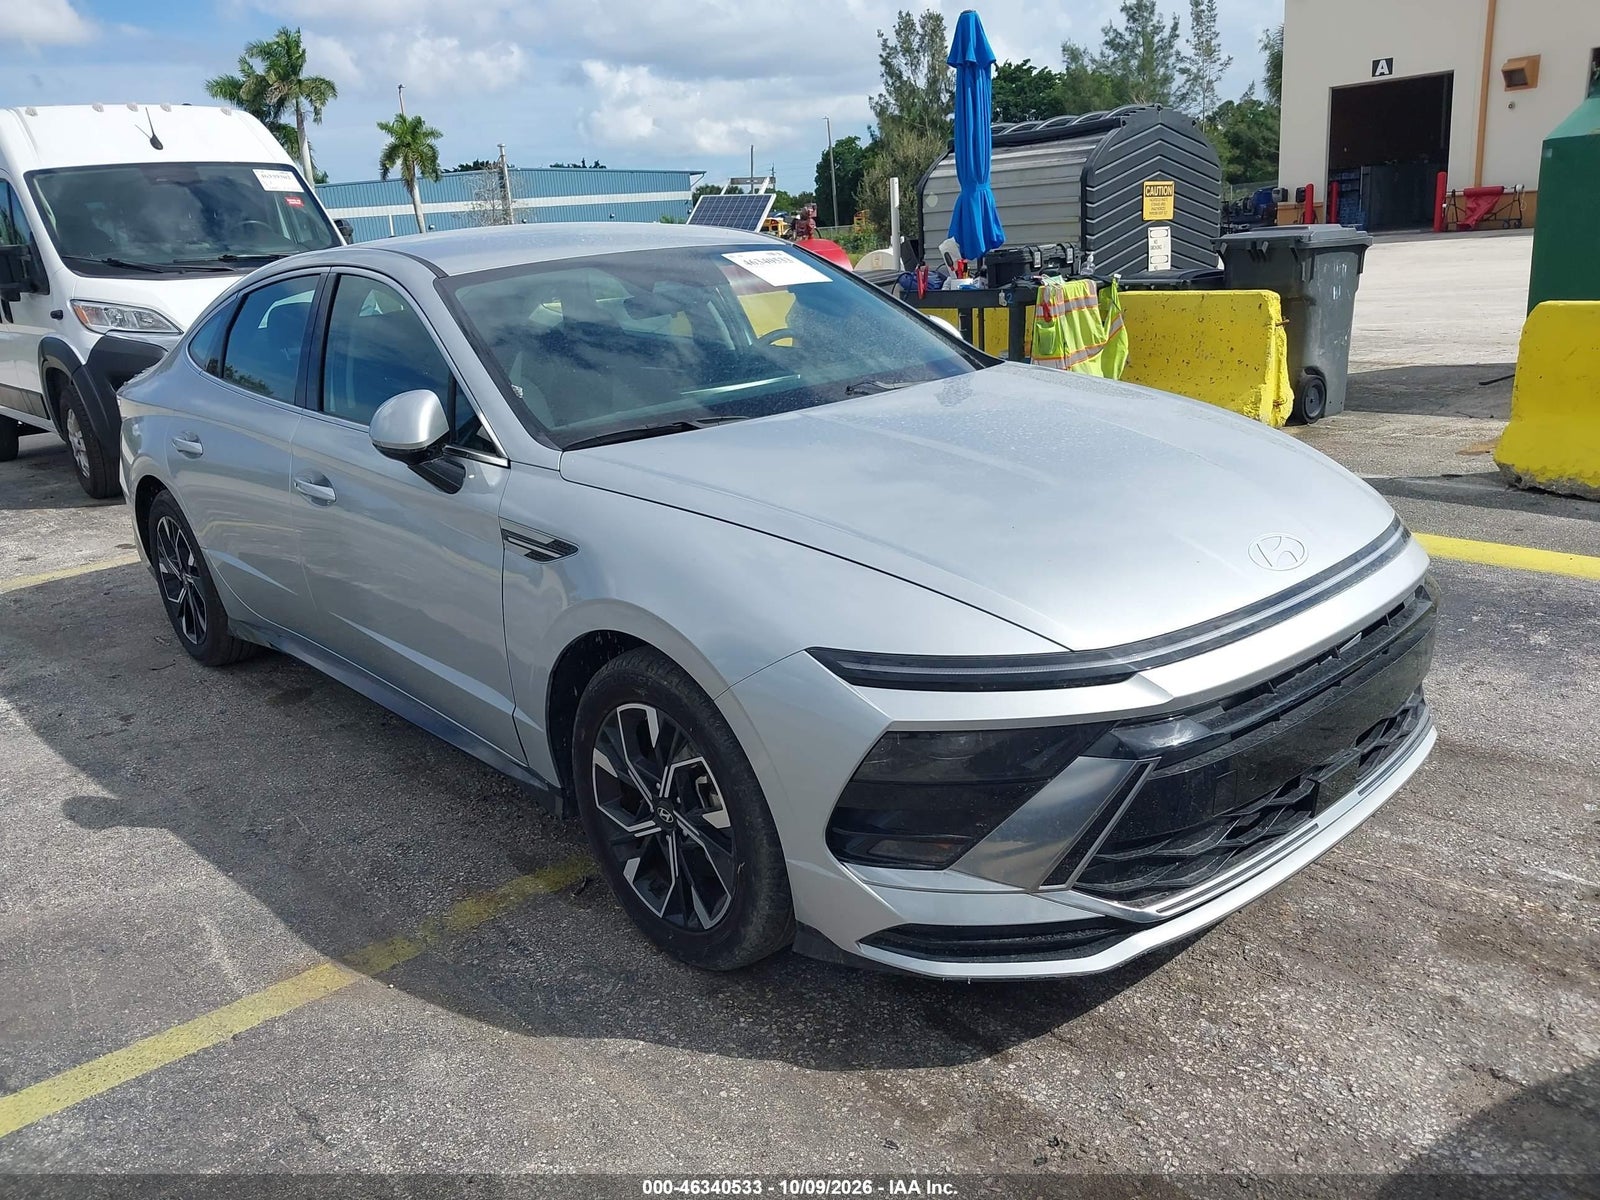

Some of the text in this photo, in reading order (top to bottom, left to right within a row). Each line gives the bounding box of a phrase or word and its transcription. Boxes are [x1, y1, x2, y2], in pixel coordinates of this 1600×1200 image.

[1375, 60, 1389, 76] A
[1145, 185, 1173, 196] CAUTION
[1006, 293, 1013, 303] 2
